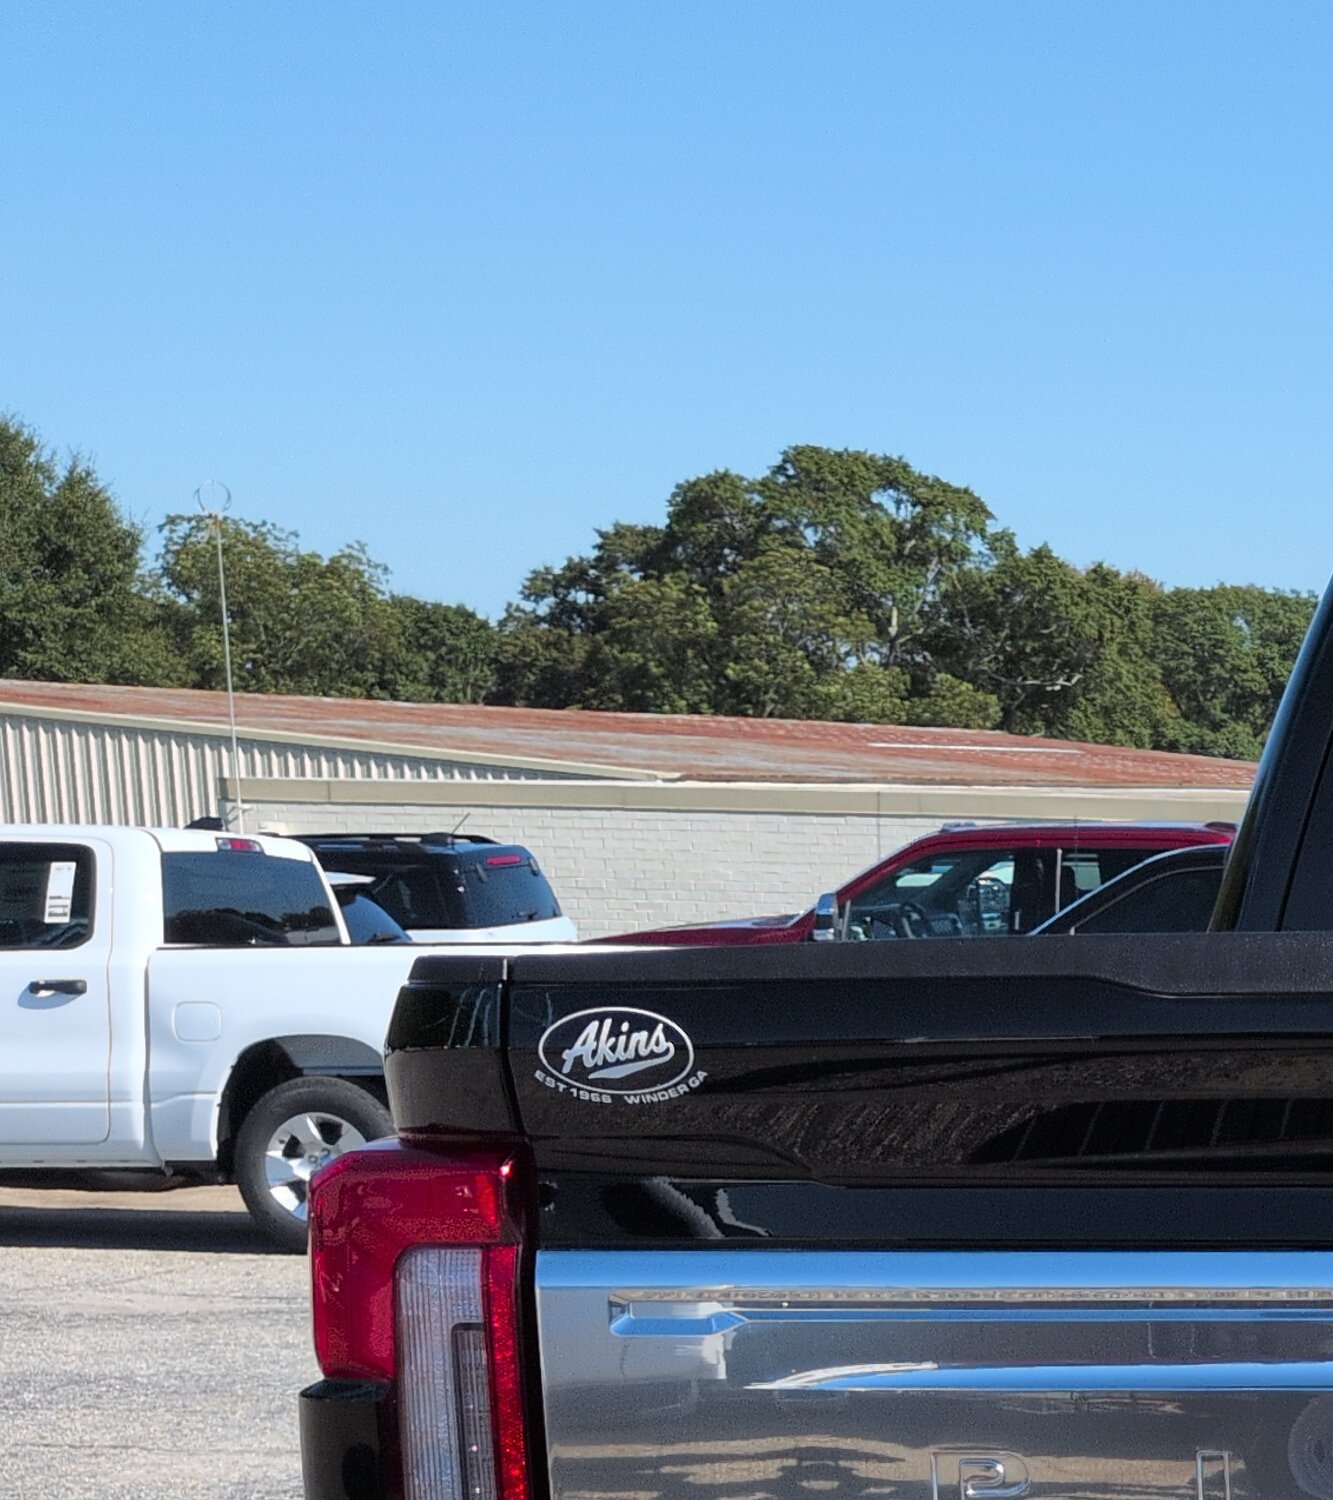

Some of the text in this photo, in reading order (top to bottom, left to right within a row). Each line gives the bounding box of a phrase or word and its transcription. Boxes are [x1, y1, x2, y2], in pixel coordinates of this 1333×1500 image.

[562, 1018, 675, 1079] Akins
[534, 1069, 567, 1093] EST
[623, 1084, 690, 1104] WINDER
[688, 1070, 709, 1088] GA
